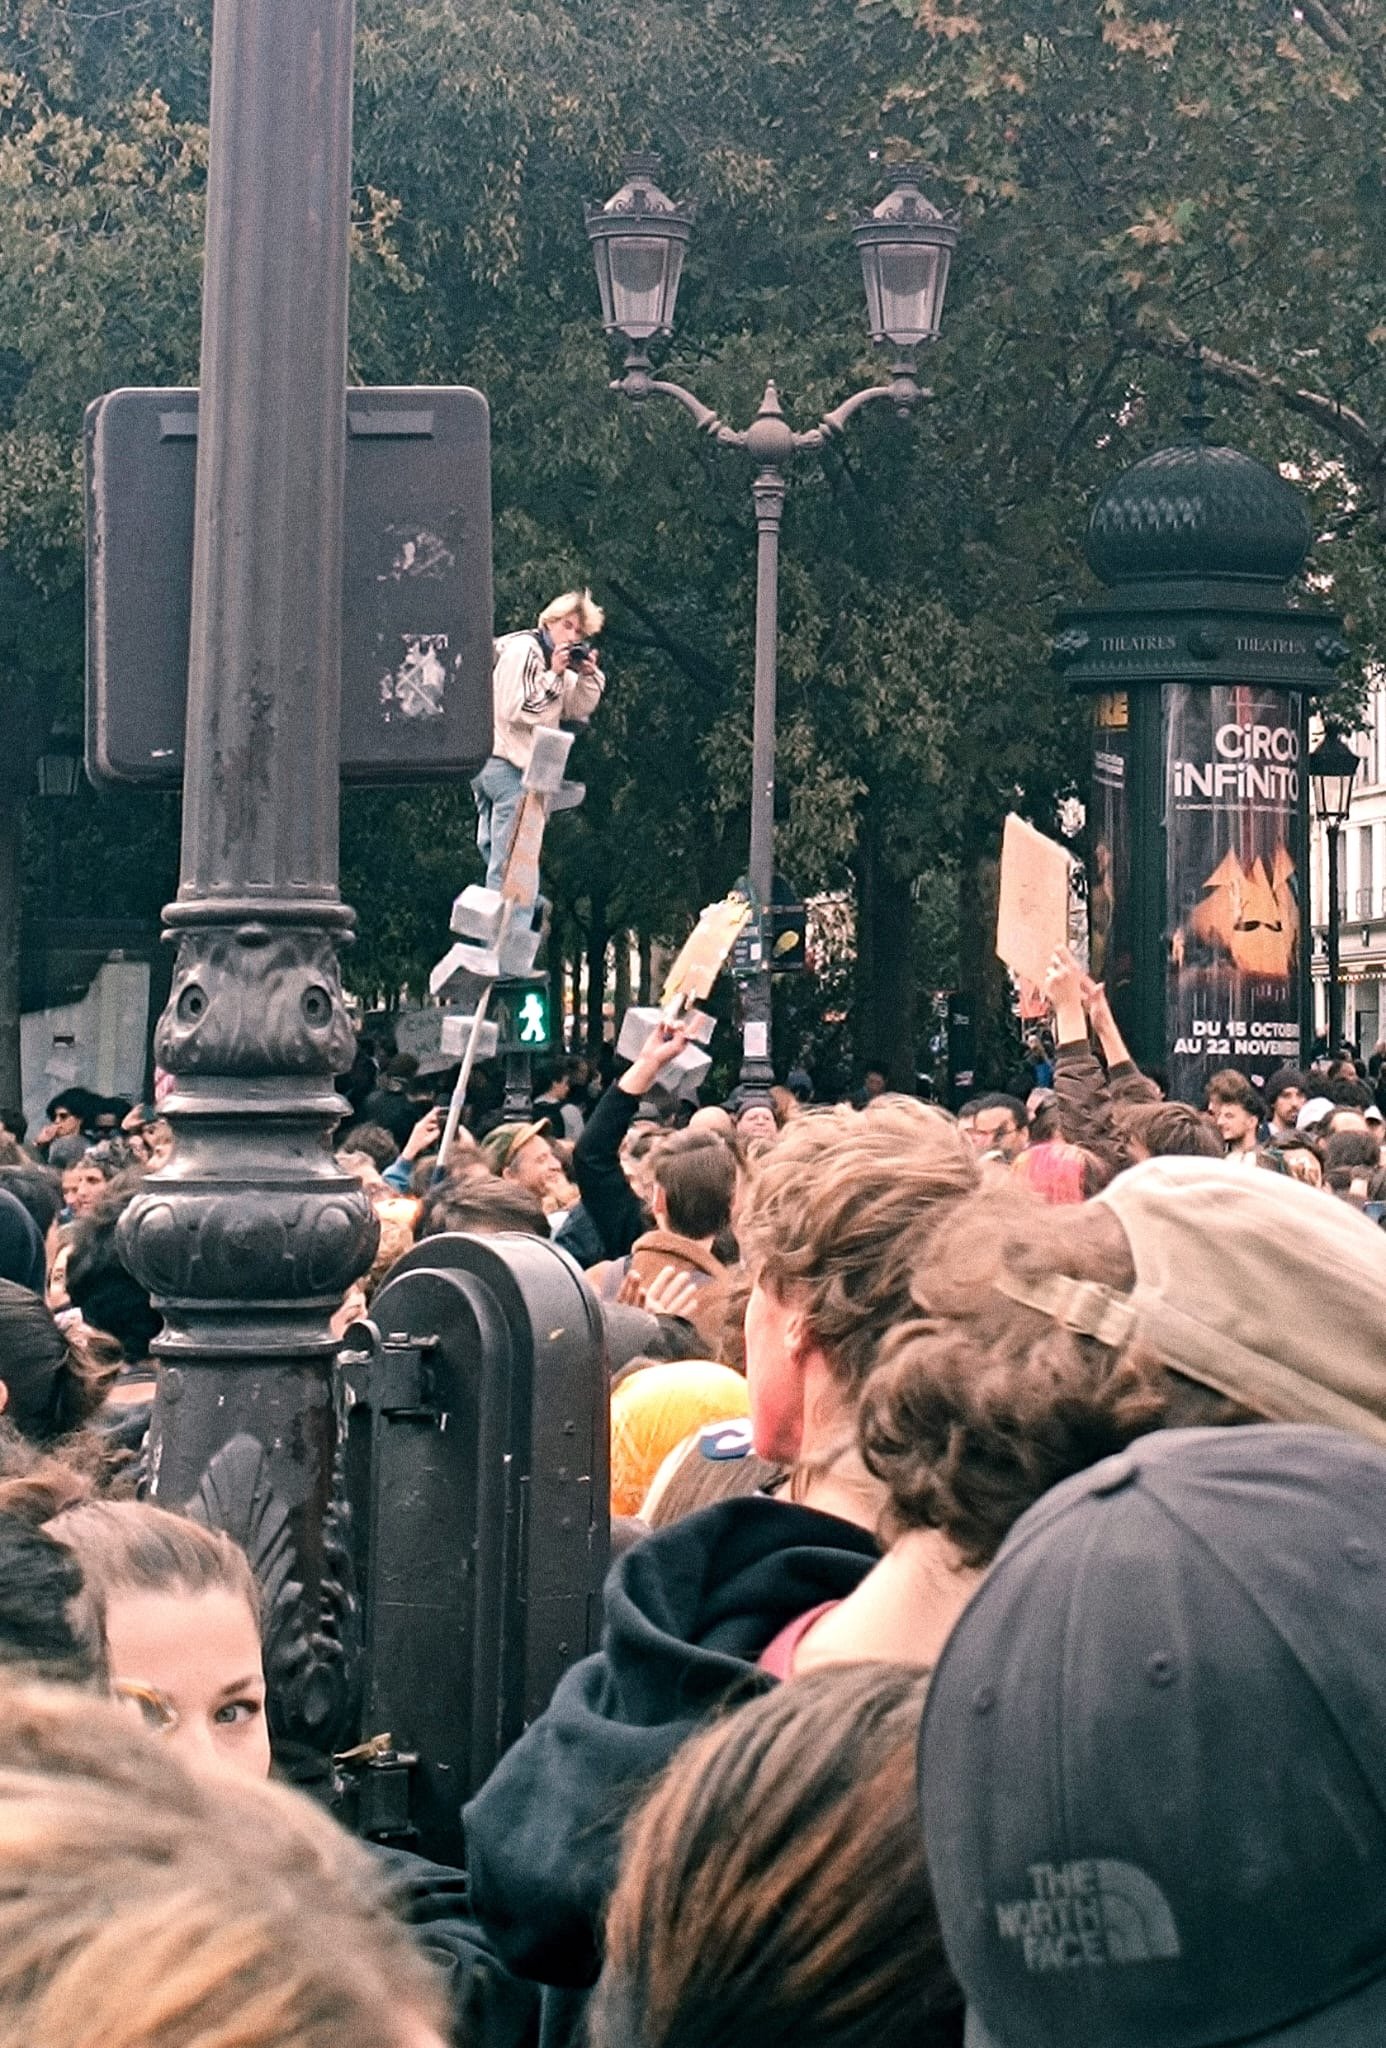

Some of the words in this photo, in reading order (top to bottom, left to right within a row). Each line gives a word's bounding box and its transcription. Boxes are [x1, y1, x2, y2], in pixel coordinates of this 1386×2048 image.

[1193, 1021, 1221, 1036] DU
[1226, 1022, 1247, 1037] 15
[1174, 1039, 1202, 1053] AU
[1207, 1040, 1230, 1054] 22
[1027, 1864, 1096, 1898] THE
